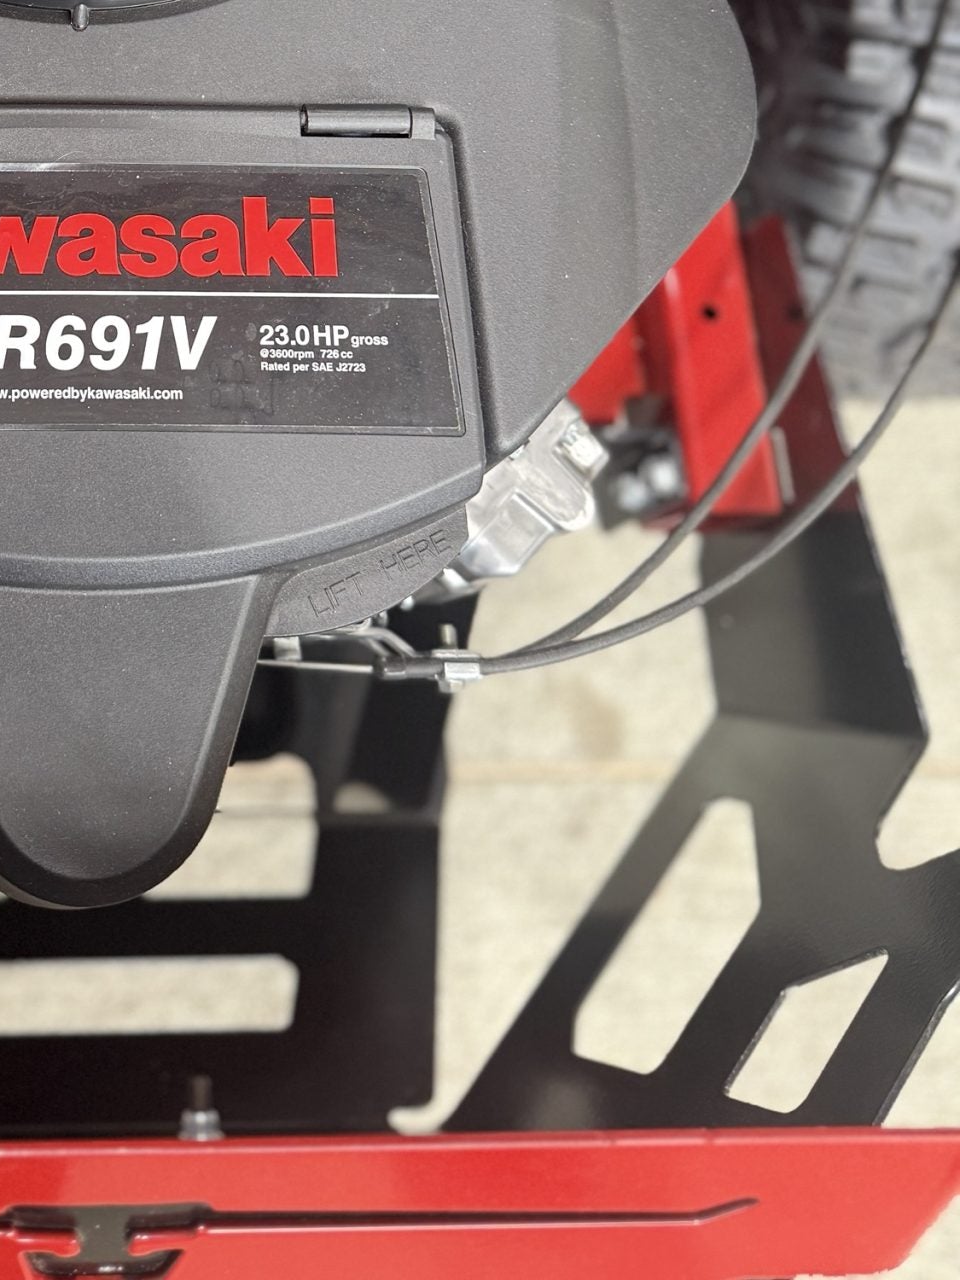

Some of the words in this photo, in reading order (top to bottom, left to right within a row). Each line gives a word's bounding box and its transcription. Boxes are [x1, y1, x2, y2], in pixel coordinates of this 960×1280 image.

[259, 325, 310, 347] 23.0
[313, 325, 350, 347] HP
[350, 335, 389, 349] gross
[259, 348, 315, 361] @3600rpm
[320, 349, 340, 359] 726
[341, 350, 354, 359] cc
[260, 361, 291, 372] Rated
[292, 363, 310, 373] per
[311, 361, 334, 372] SAE
[335, 362, 367, 373] J2723
[306, 571, 364, 618] LIFT
[378, 529, 452, 582] HERE
